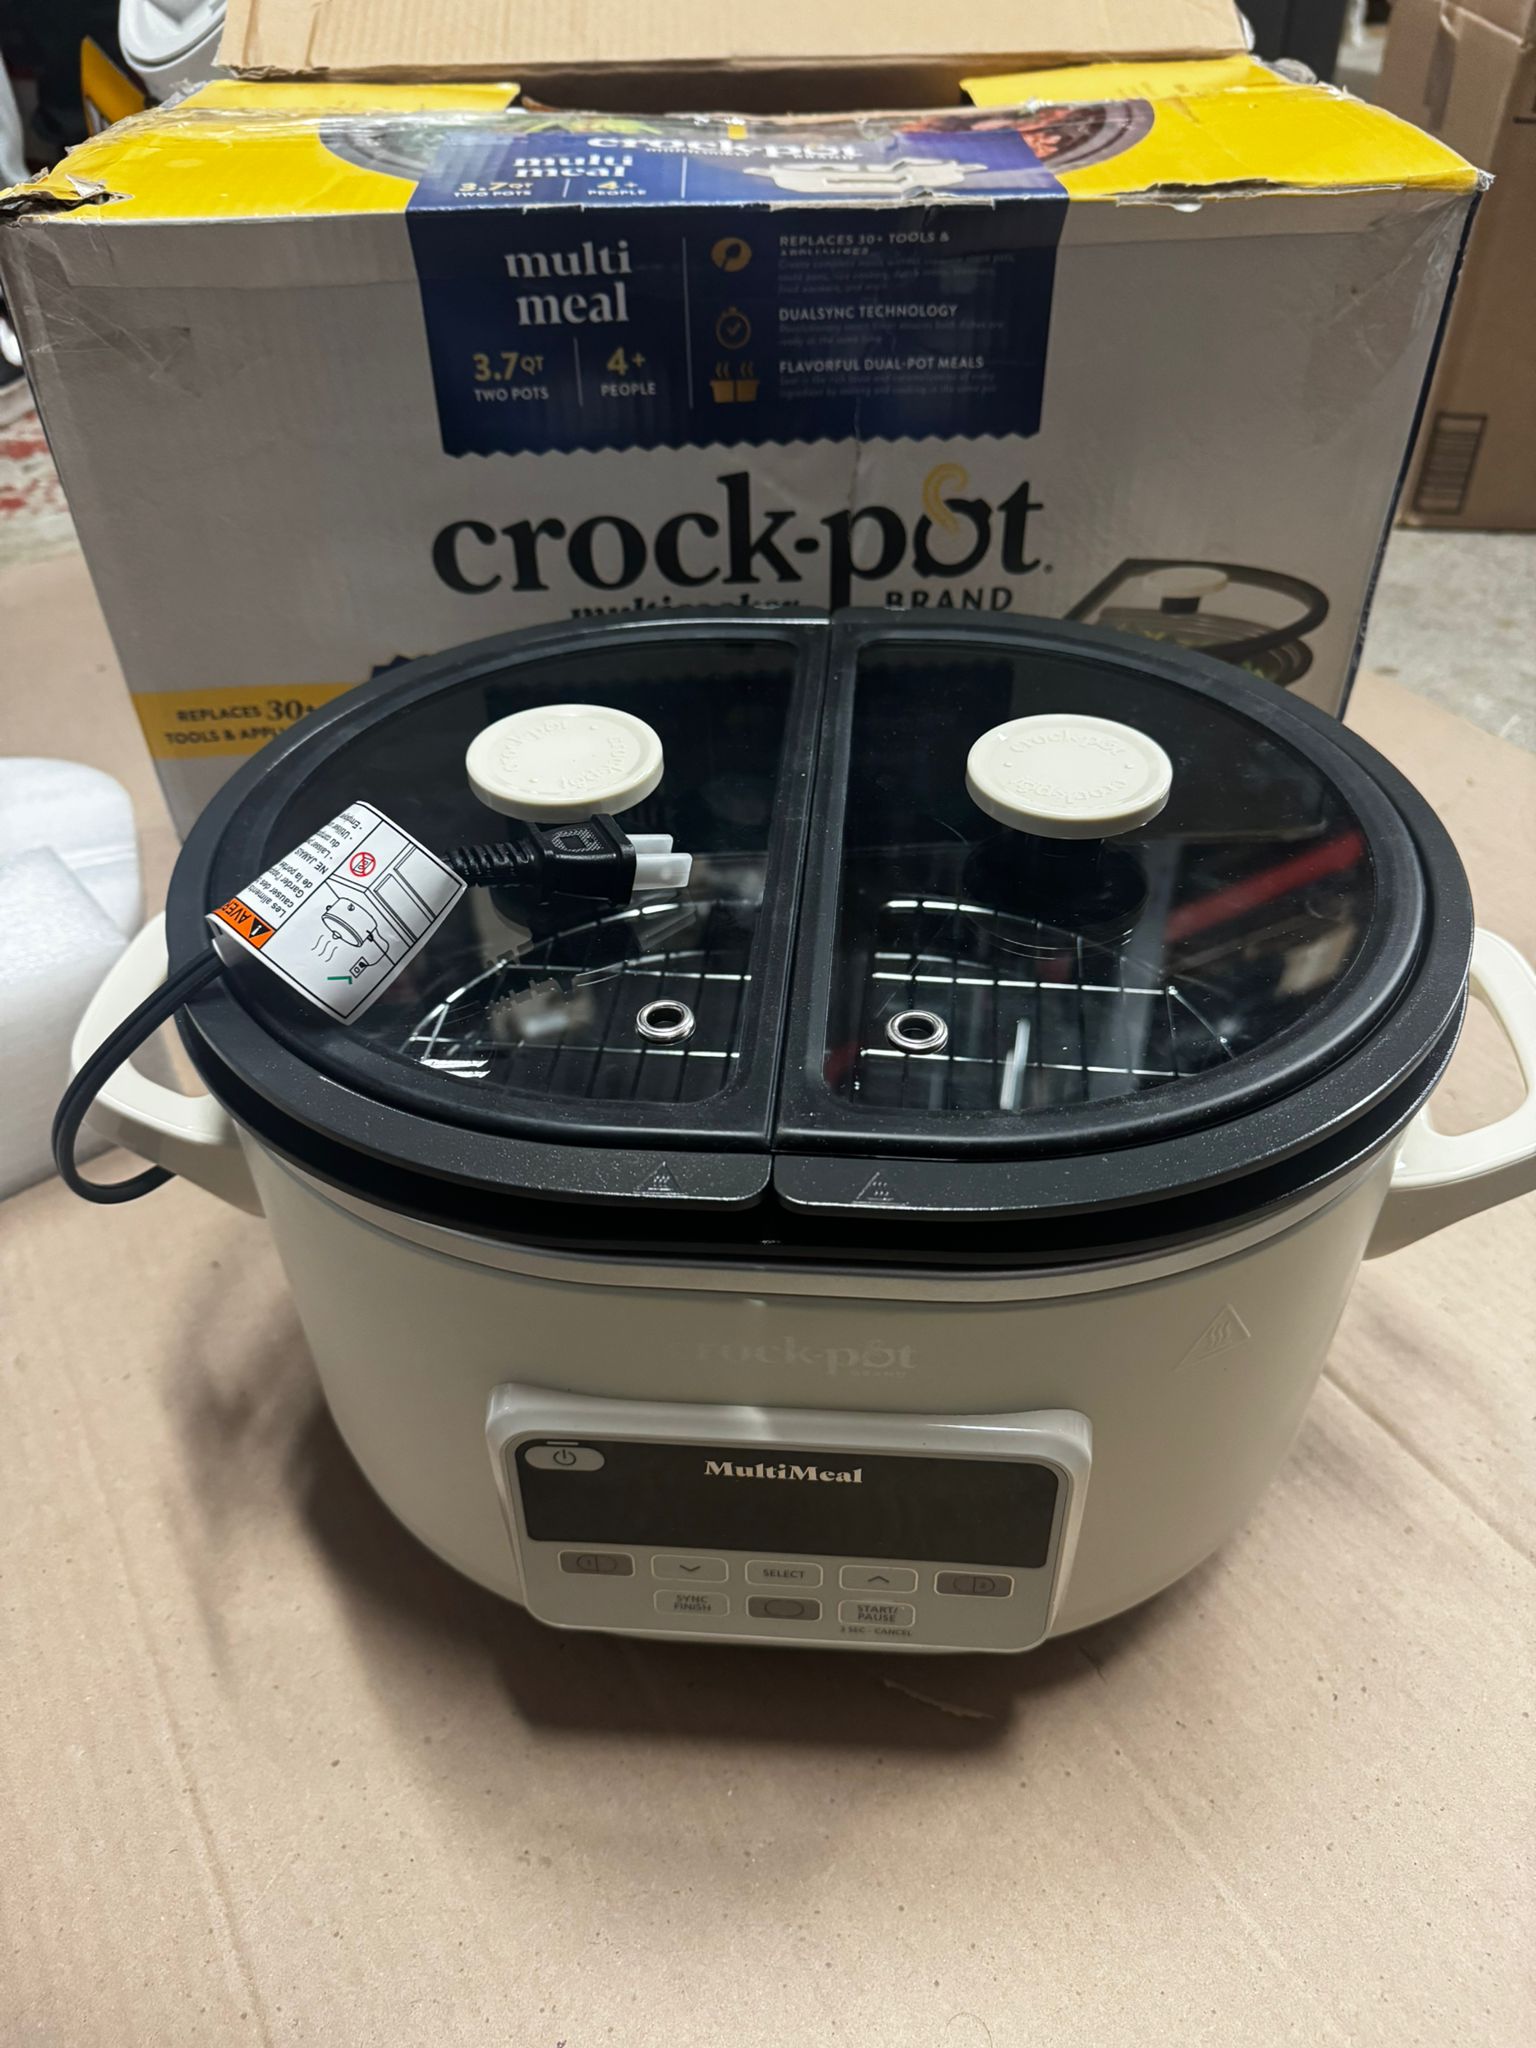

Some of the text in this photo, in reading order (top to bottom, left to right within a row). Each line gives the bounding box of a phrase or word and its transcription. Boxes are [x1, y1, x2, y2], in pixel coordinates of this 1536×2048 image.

[513, 154, 634, 168] multi
[515, 166, 625, 178] meal
[454, 189, 533, 198] TWO POTS
[587, 188, 647, 197] PEOPLE
[779, 234, 854, 247] REPLACES
[889, 231, 935, 244] TOOLS
[504, 240, 632, 278] multi
[516, 281, 629, 326] meal
[779, 304, 958, 321] DUALSYNC TECHNOLOGY
[473, 351, 544, 381] 3.7QT
[607, 347, 646, 376] 4+
[779, 355, 984, 374] FLAVORFUL DUAL-POT MEALS
[474, 386, 549, 402] TWO POTS
[601, 382, 656, 396] PEOPLE
[886, 587, 1012, 611] BRAND
[176, 705, 262, 722] REPLACES
[165, 728, 220, 745] TOOLS
[223, 729, 236, 741] &
[313, 861, 329, 875] NE
[280, 877, 305, 898] Garder
[269, 887, 294, 908] causer
[271, 902, 287, 918] Les
[704, 1460, 863, 1484] MultiMeal
[763, 1568, 805, 1579] SELECT
[673, 1602, 712, 1613] FINISH
[676, 1594, 709, 1605] SYNC
[857, 1613, 897, 1624] PAUSE
[849, 1626, 866, 1636] SEC
[874, 1628, 912, 1638] CANCEL
